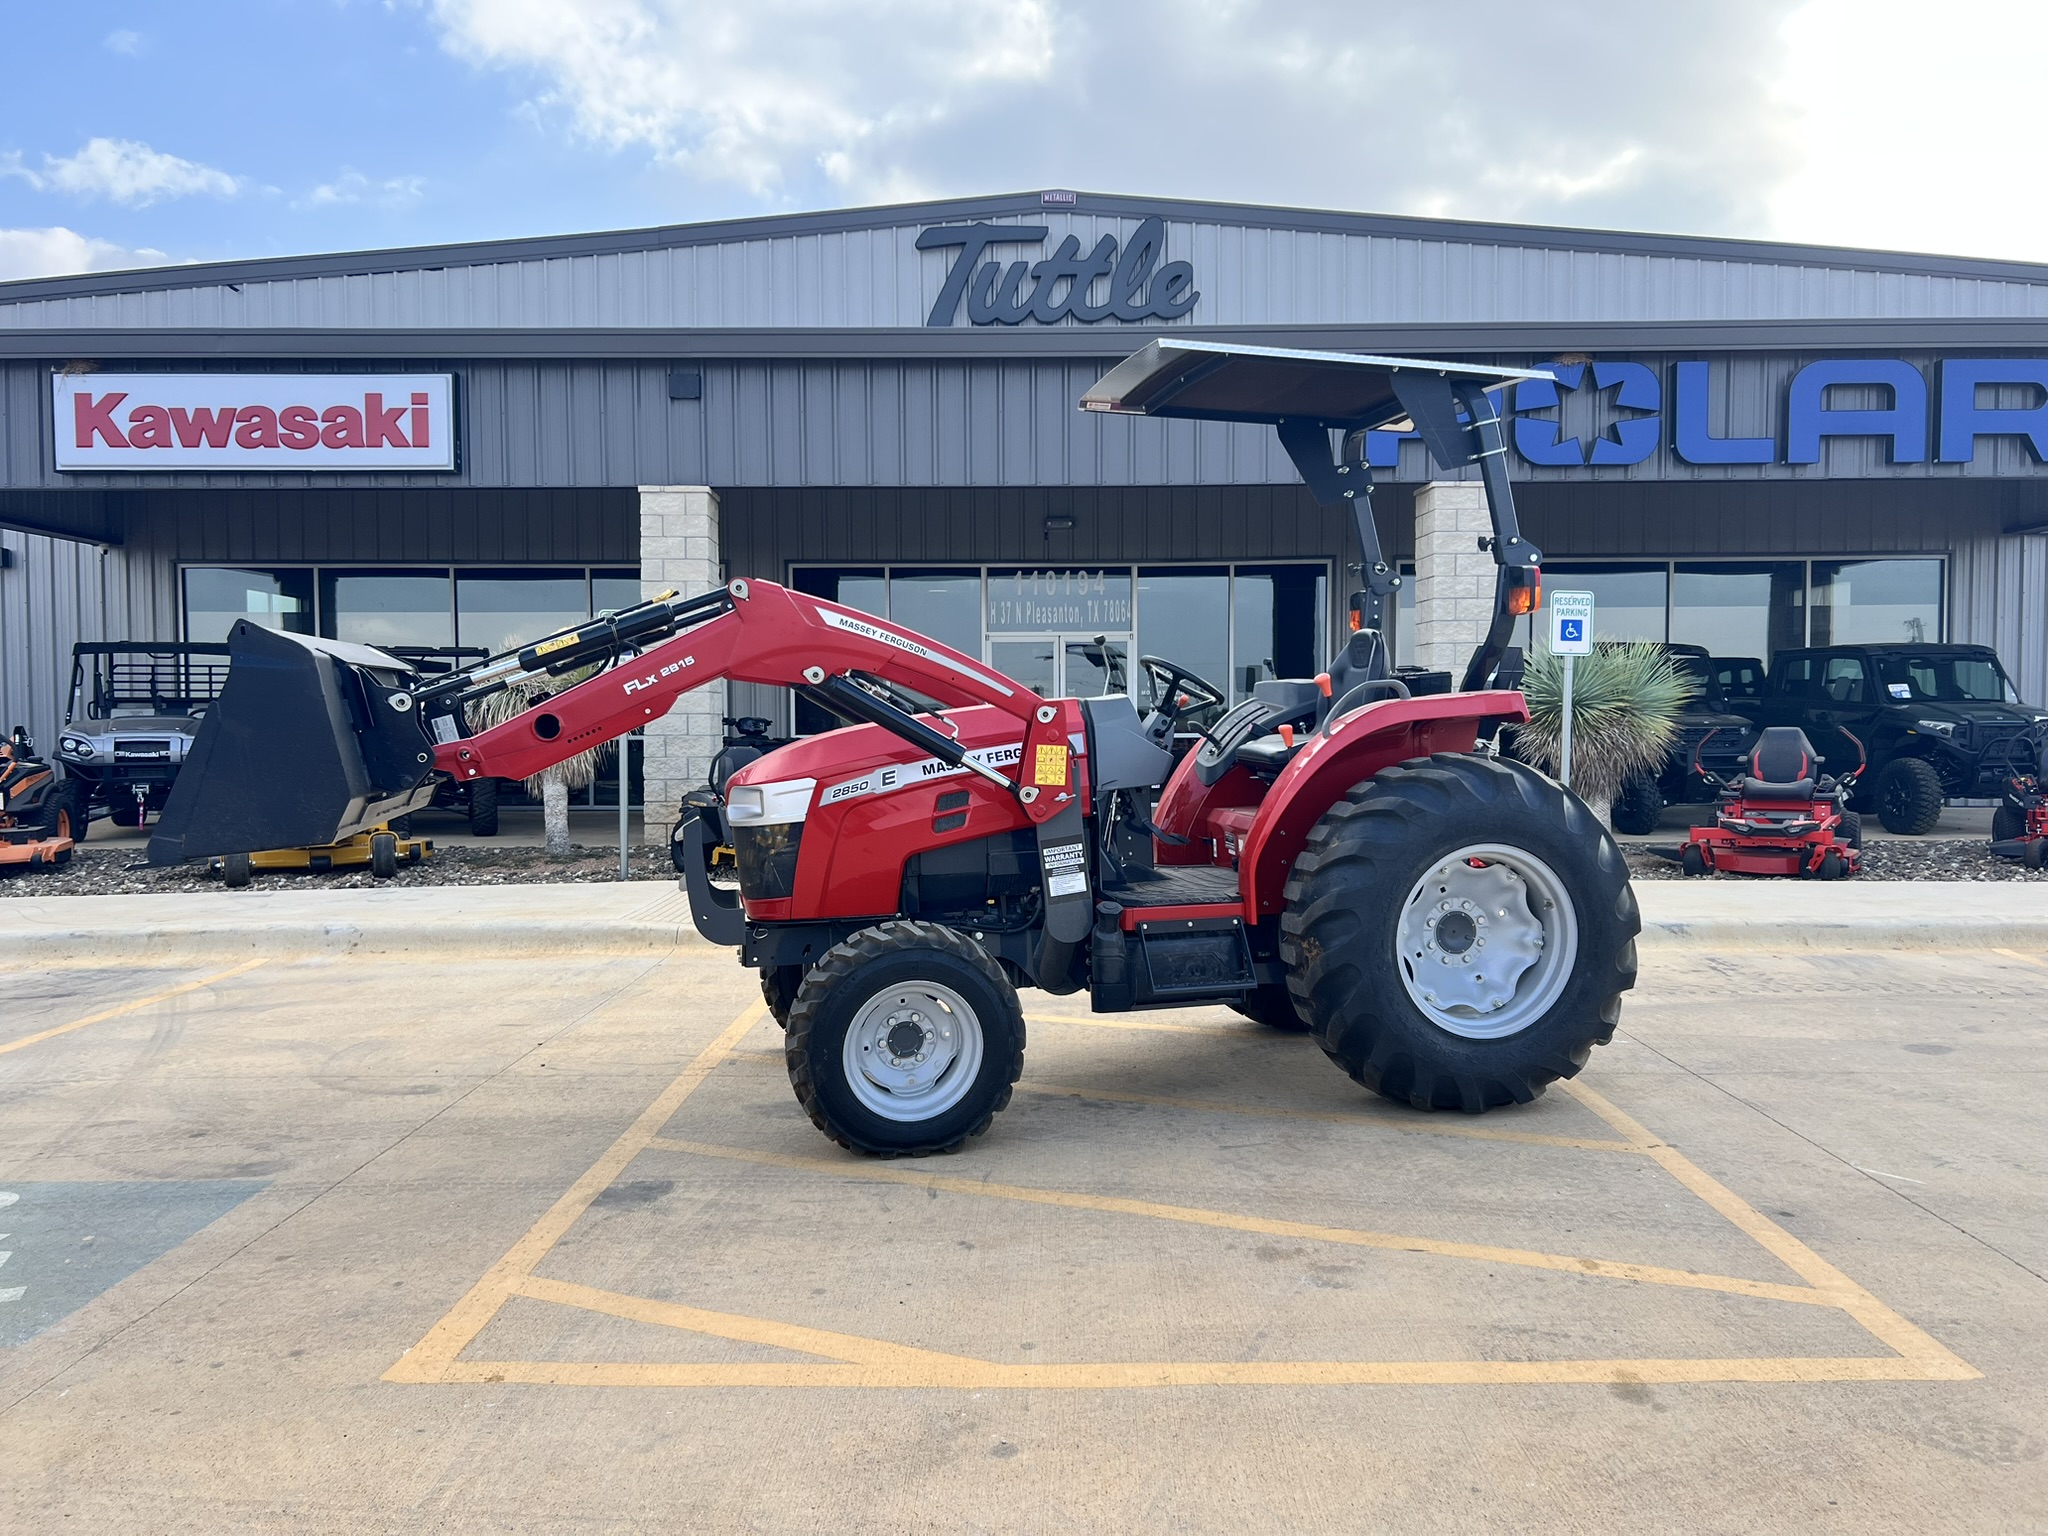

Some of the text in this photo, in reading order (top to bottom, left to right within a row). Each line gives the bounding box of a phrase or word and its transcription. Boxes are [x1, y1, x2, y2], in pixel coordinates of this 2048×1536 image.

[1044, 193, 1073, 202] METALLIC
[915, 216, 1200, 327] Tuttle
[74, 392, 429, 450] Kawasaki
[1013, 570, 1106, 596] 110194
[1554, 597, 1591, 606] RESERVED
[1556, 608, 1588, 617] PARKING
[1000, 601, 1011, 625] 37
[1015, 601, 1022, 624] N
[1026, 601, 1083, 628] Pleasanton,
[1087, 599, 1100, 623] TX
[1104, 599, 1131, 623] 78064
[839, 618, 928, 656] MASSEY FERGUSON
[660, 655, 696, 677] 2815
[832, 780, 869, 798] 2850
[882, 769, 896, 787] E
[1044, 851, 1083, 863] WARRANTY
[1046, 844, 1080, 854] IMPORTANT
[1048, 859, 1082, 868] INFORMATION
